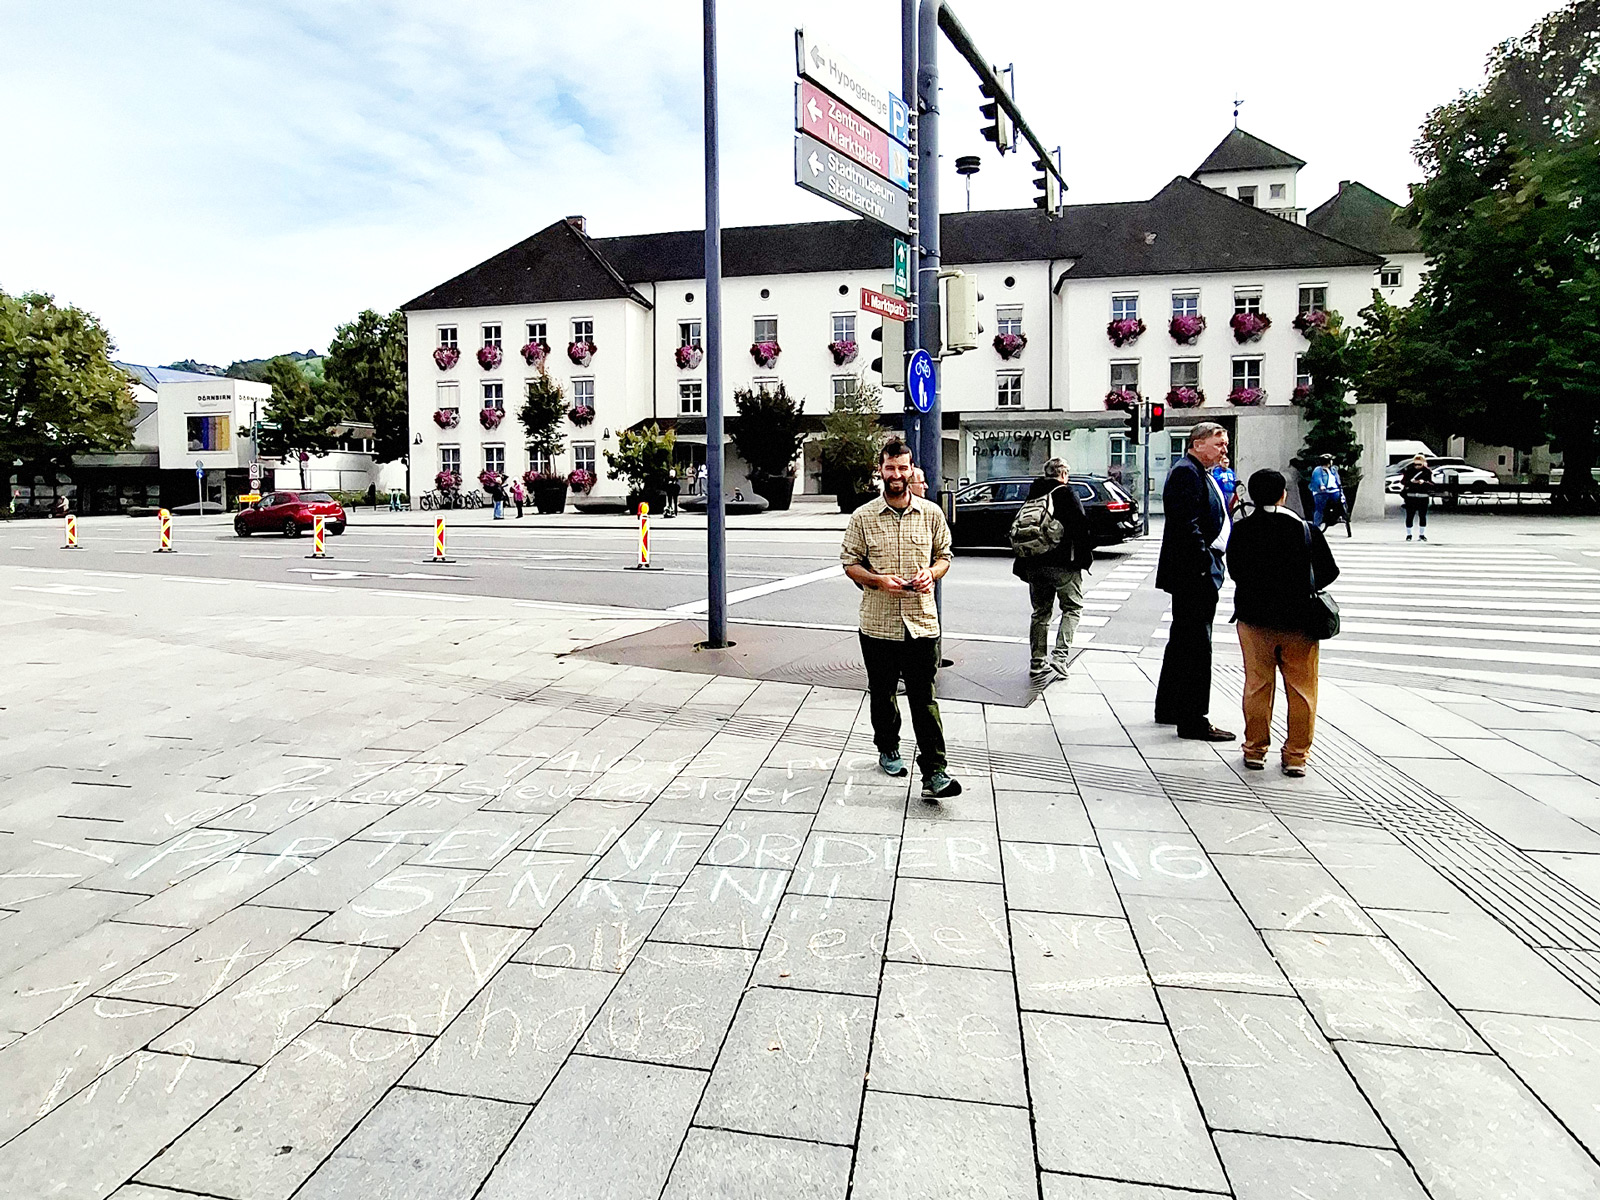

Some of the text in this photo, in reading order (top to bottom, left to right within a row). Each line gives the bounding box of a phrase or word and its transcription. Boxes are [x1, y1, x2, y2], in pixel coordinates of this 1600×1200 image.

[828, 58, 888, 116] Hypogarage
[827, 99, 871, 142] Zentrum
[827, 122, 882, 170] Marktplatz
[827, 152, 896, 205] Stadtmuseum
[827, 176, 886, 219] Stadtarchiv
[870, 295, 905, 317] Marktplatz
[972, 430, 1072, 441] STADTGARAGE
[972, 446, 1030, 457] Rathaus
[163, 800, 257, 829] von
